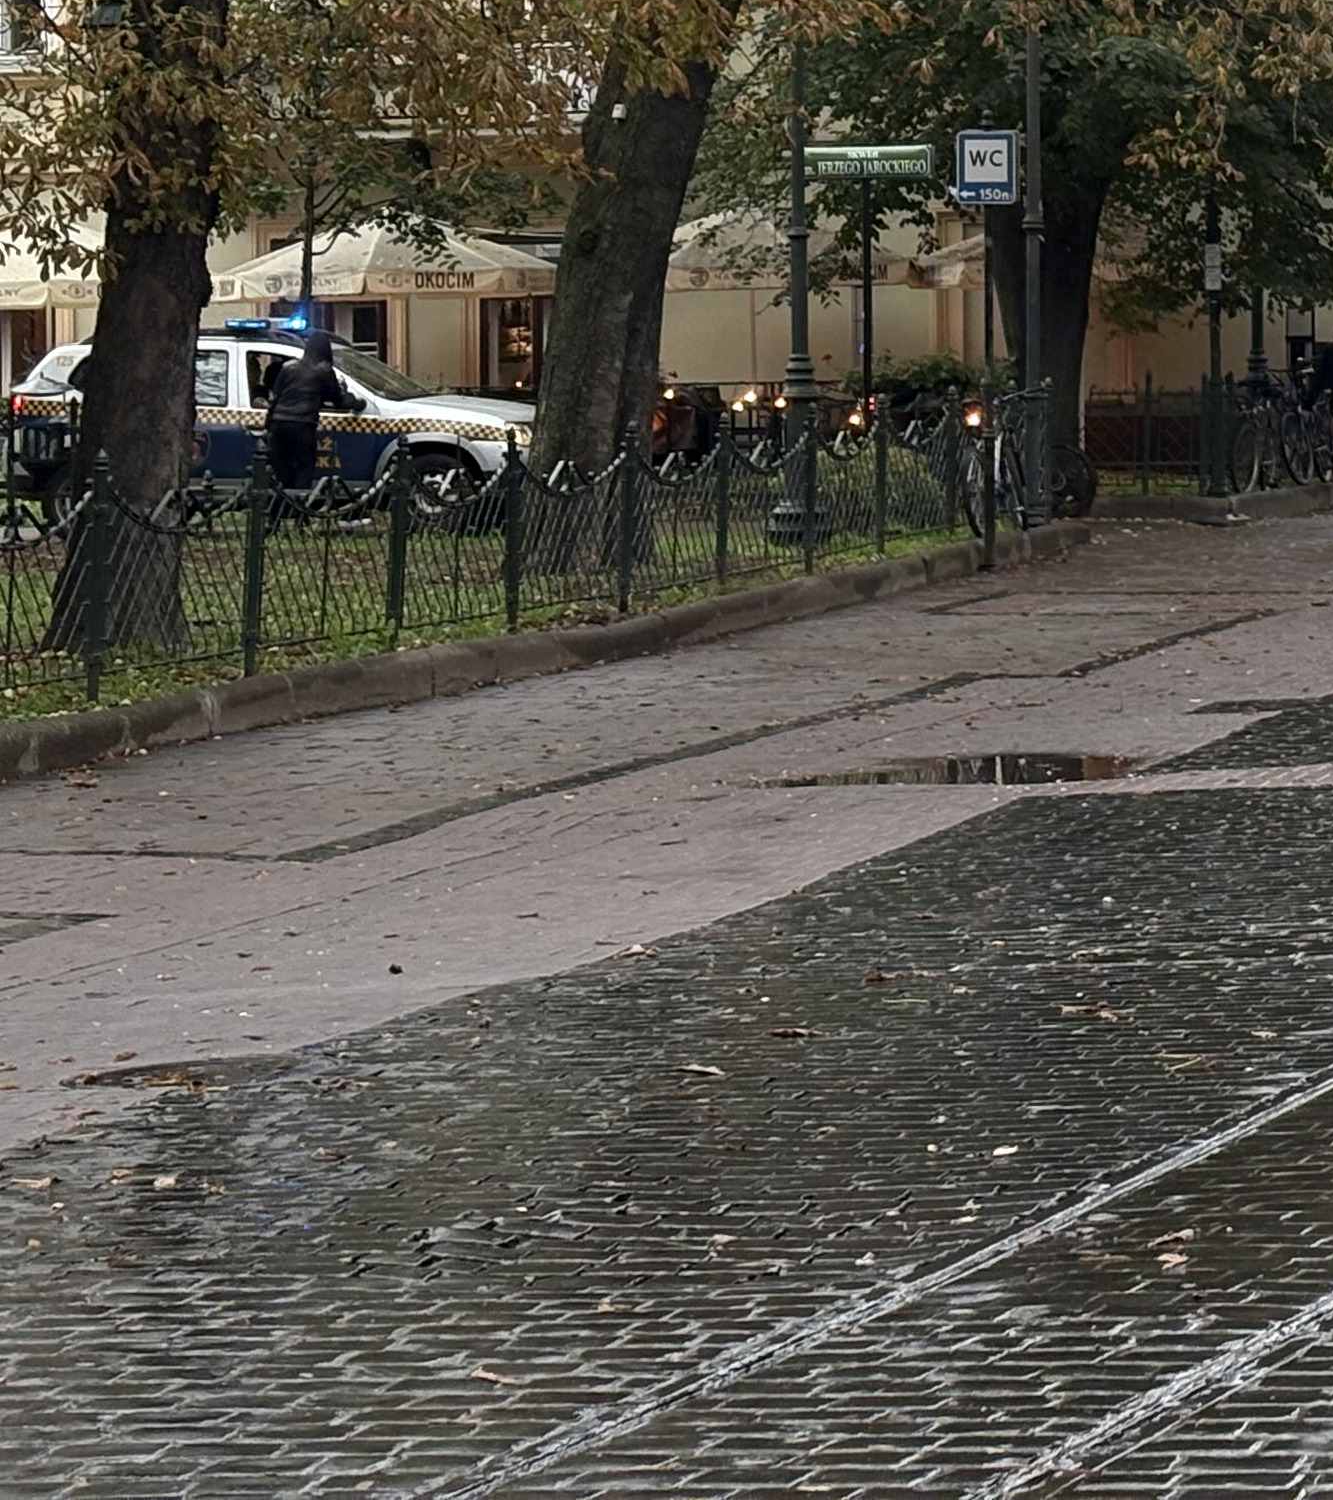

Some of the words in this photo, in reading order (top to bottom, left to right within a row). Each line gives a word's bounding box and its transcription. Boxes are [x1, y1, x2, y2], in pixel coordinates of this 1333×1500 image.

[969, 150, 1003, 167] WC
[817, 161, 860, 176] JERZEGO
[863, 160, 927, 176] JAROCKIEGO
[414, 272, 475, 289] OKOCIM
